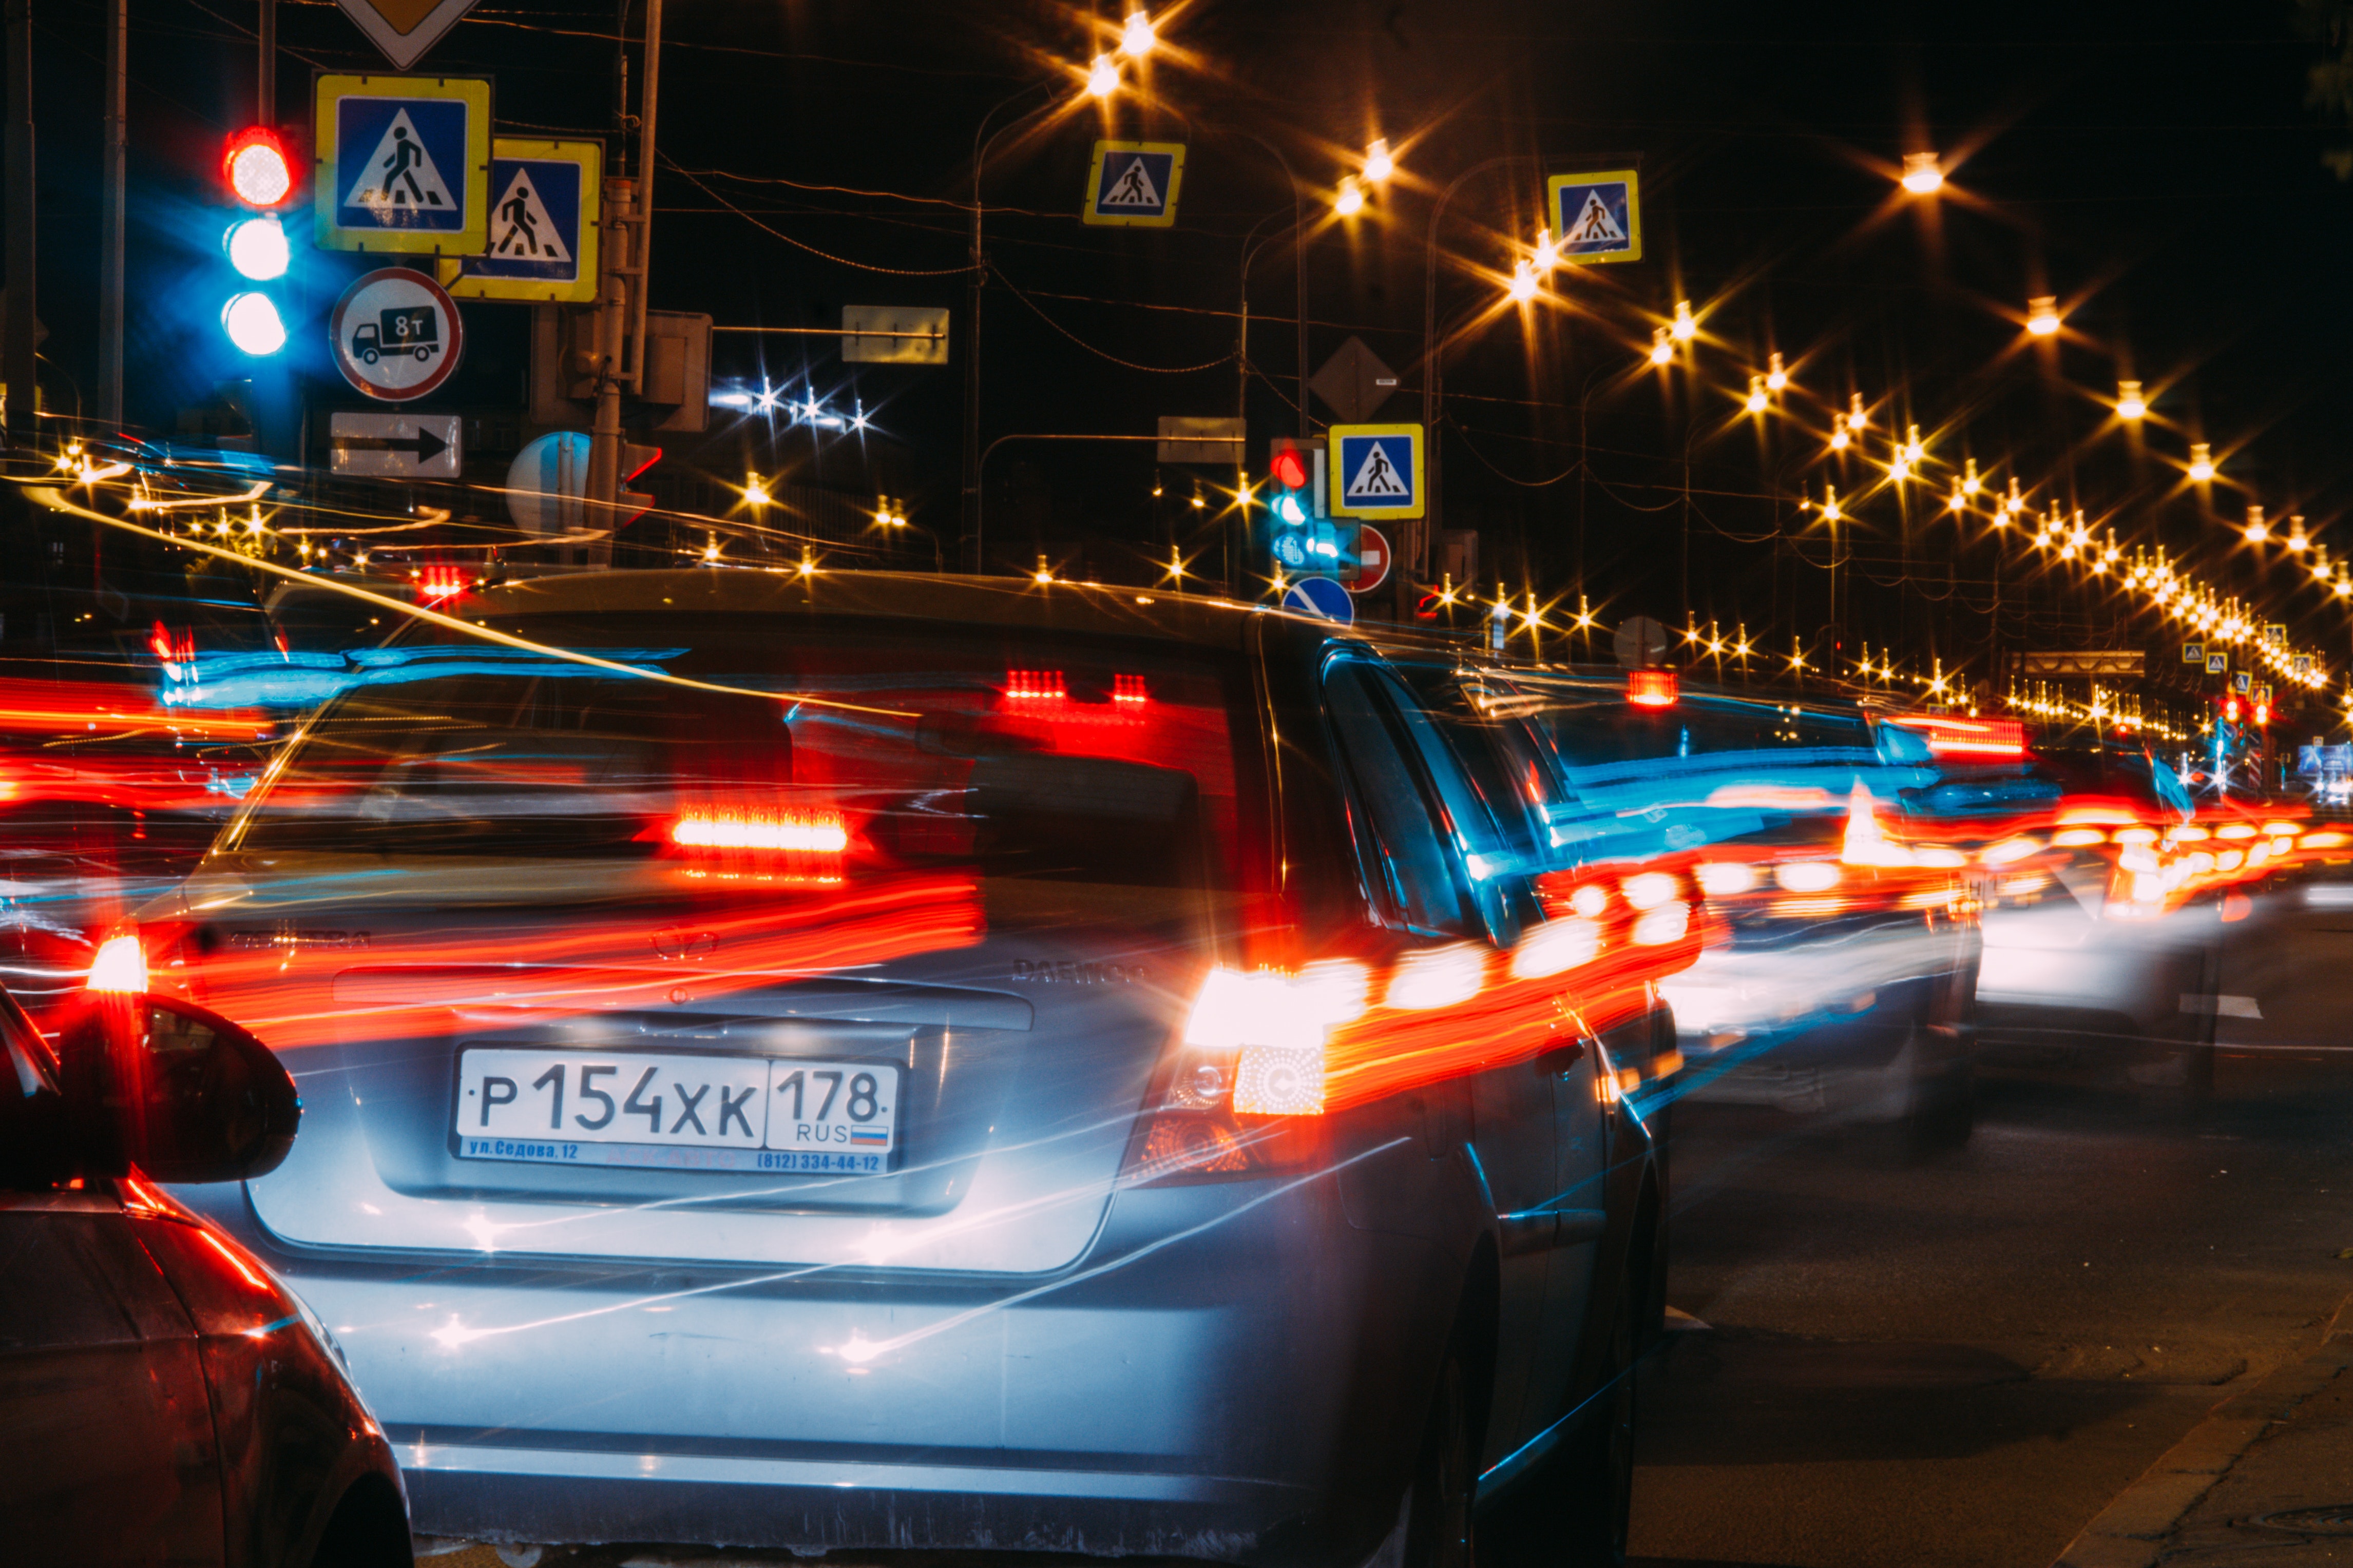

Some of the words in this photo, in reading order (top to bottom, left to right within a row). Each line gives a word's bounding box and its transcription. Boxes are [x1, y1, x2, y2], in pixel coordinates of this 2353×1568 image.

[776, 1070, 878, 1122] 178
[797, 1124, 847, 1143] RUS
[562, 1145, 578, 1159] 12
[757, 1153, 796, 1169] (812)
[801, 1155, 879, 1171] 334-44-12
